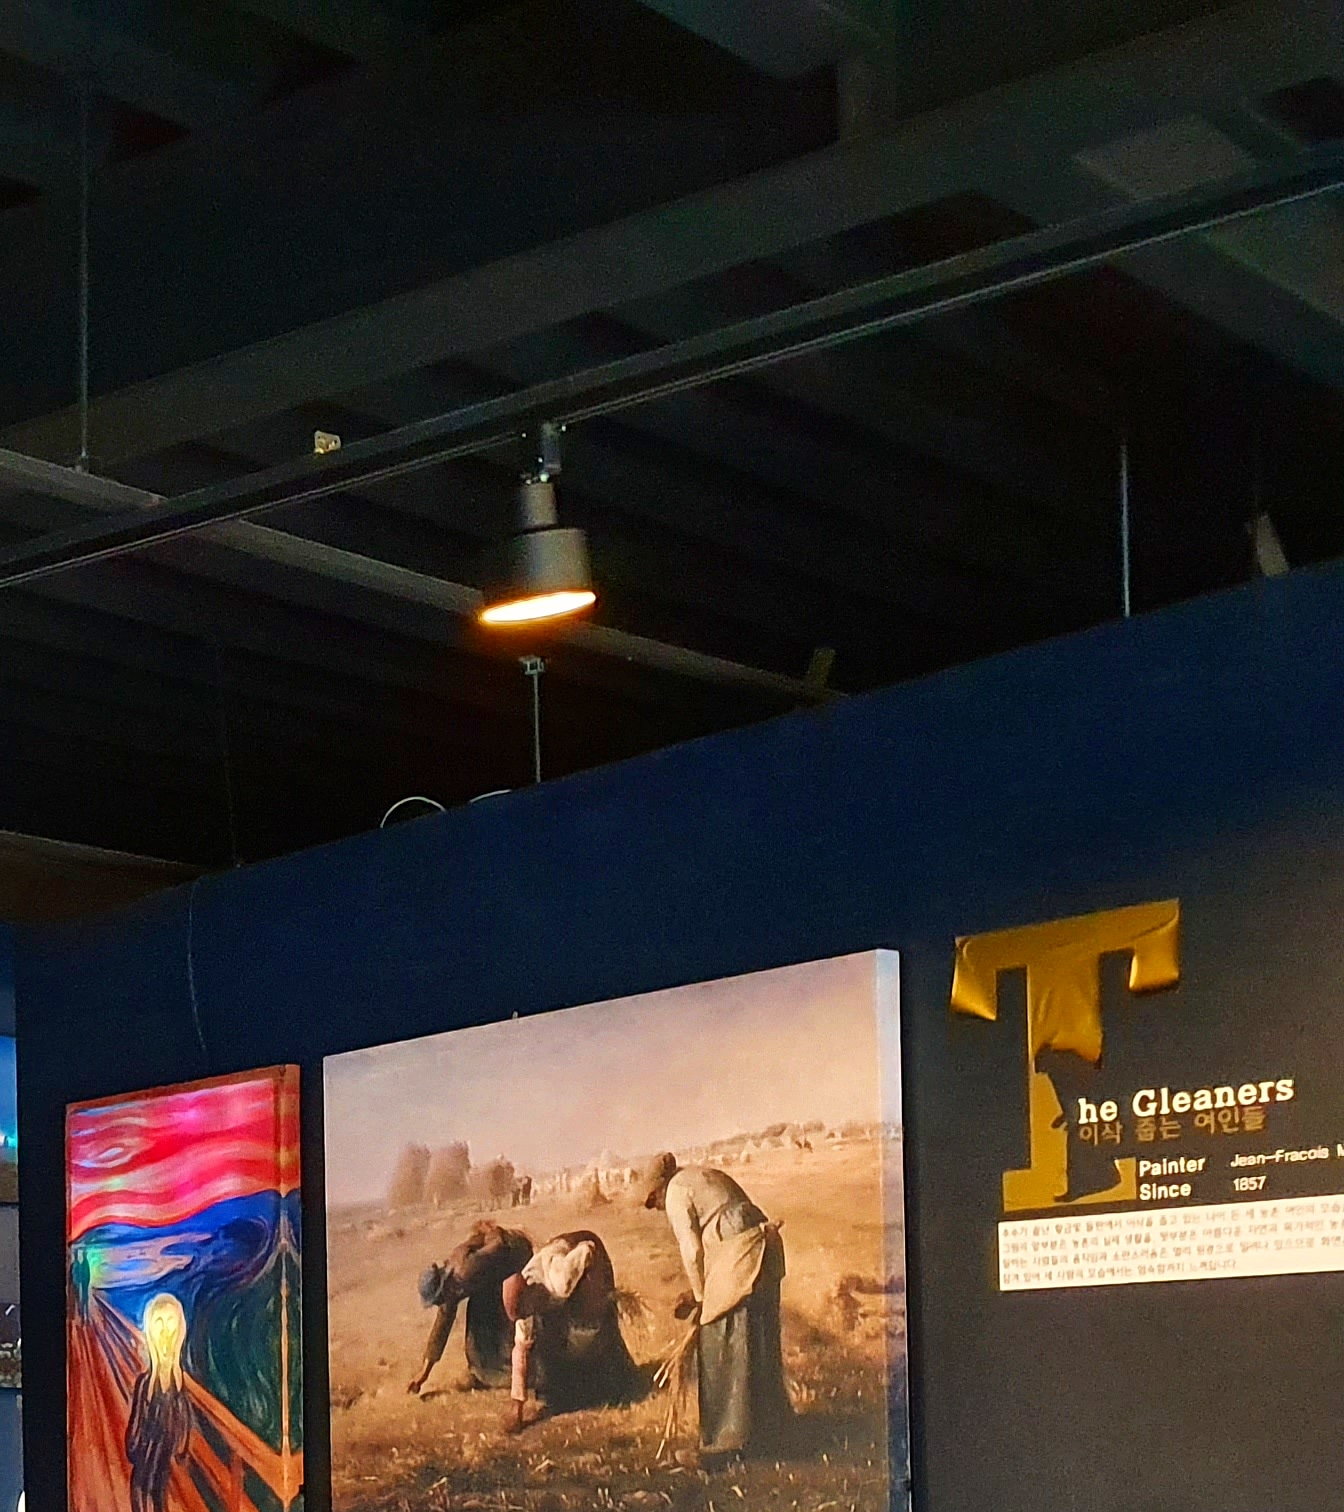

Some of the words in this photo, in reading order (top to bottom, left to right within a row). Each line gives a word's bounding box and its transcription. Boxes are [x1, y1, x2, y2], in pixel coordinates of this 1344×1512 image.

[1132, 1079, 1294, 1117] Gleaners
[1194, 1107, 1266, 1134] 여인들
[1139, 1157, 1205, 1177] Painter
[1140, 1183, 1192, 1200] Since
[1233, 1176, 1266, 1191] 1857
